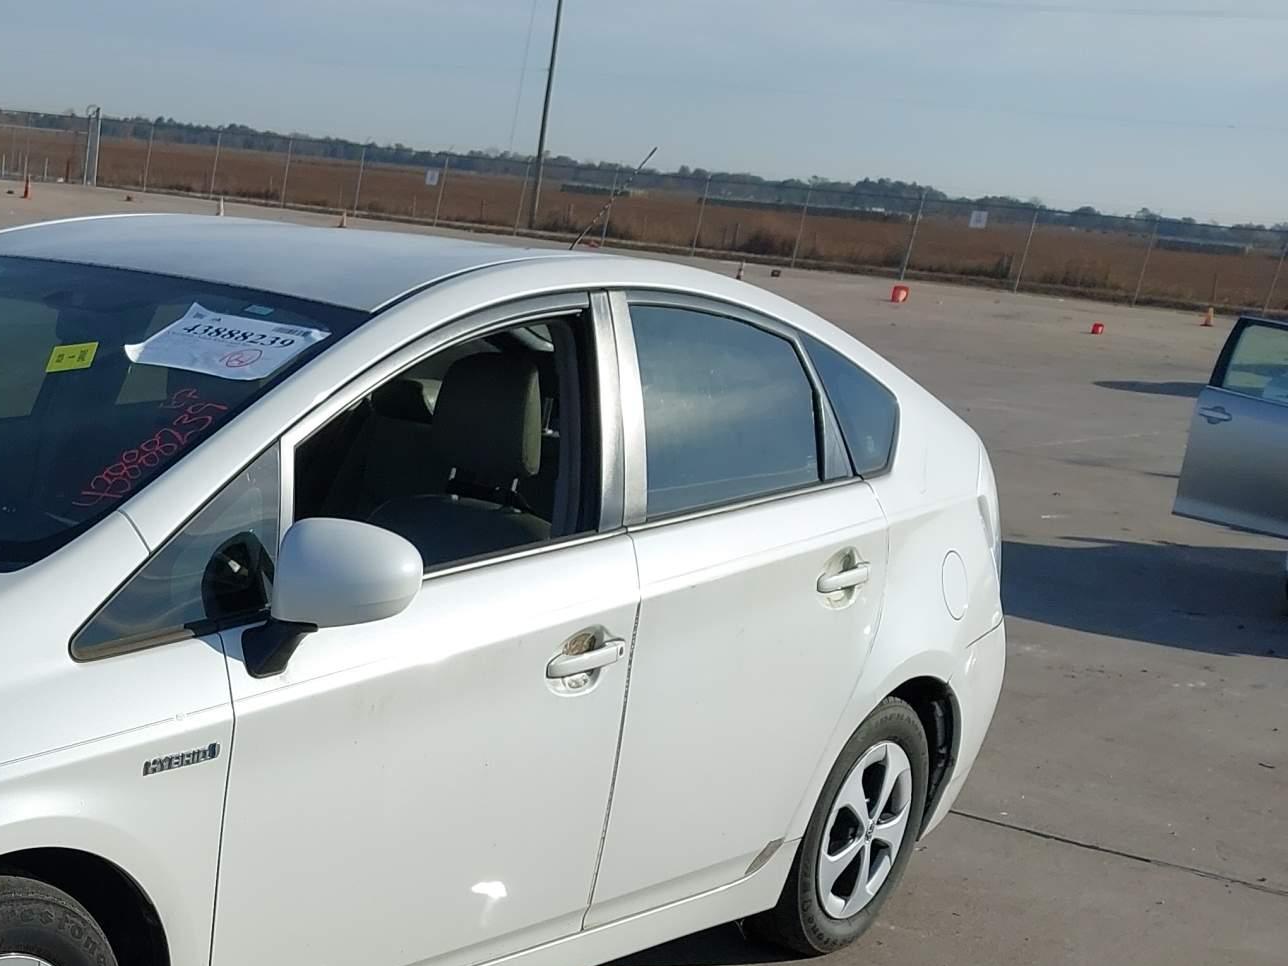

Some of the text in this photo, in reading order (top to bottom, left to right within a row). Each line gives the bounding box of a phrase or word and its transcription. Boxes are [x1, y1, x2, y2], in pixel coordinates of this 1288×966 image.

[183, 323, 296, 349] 43888239
[72, 402, 230, 506] 43888239
[142, 748, 211, 776] HYBRID
